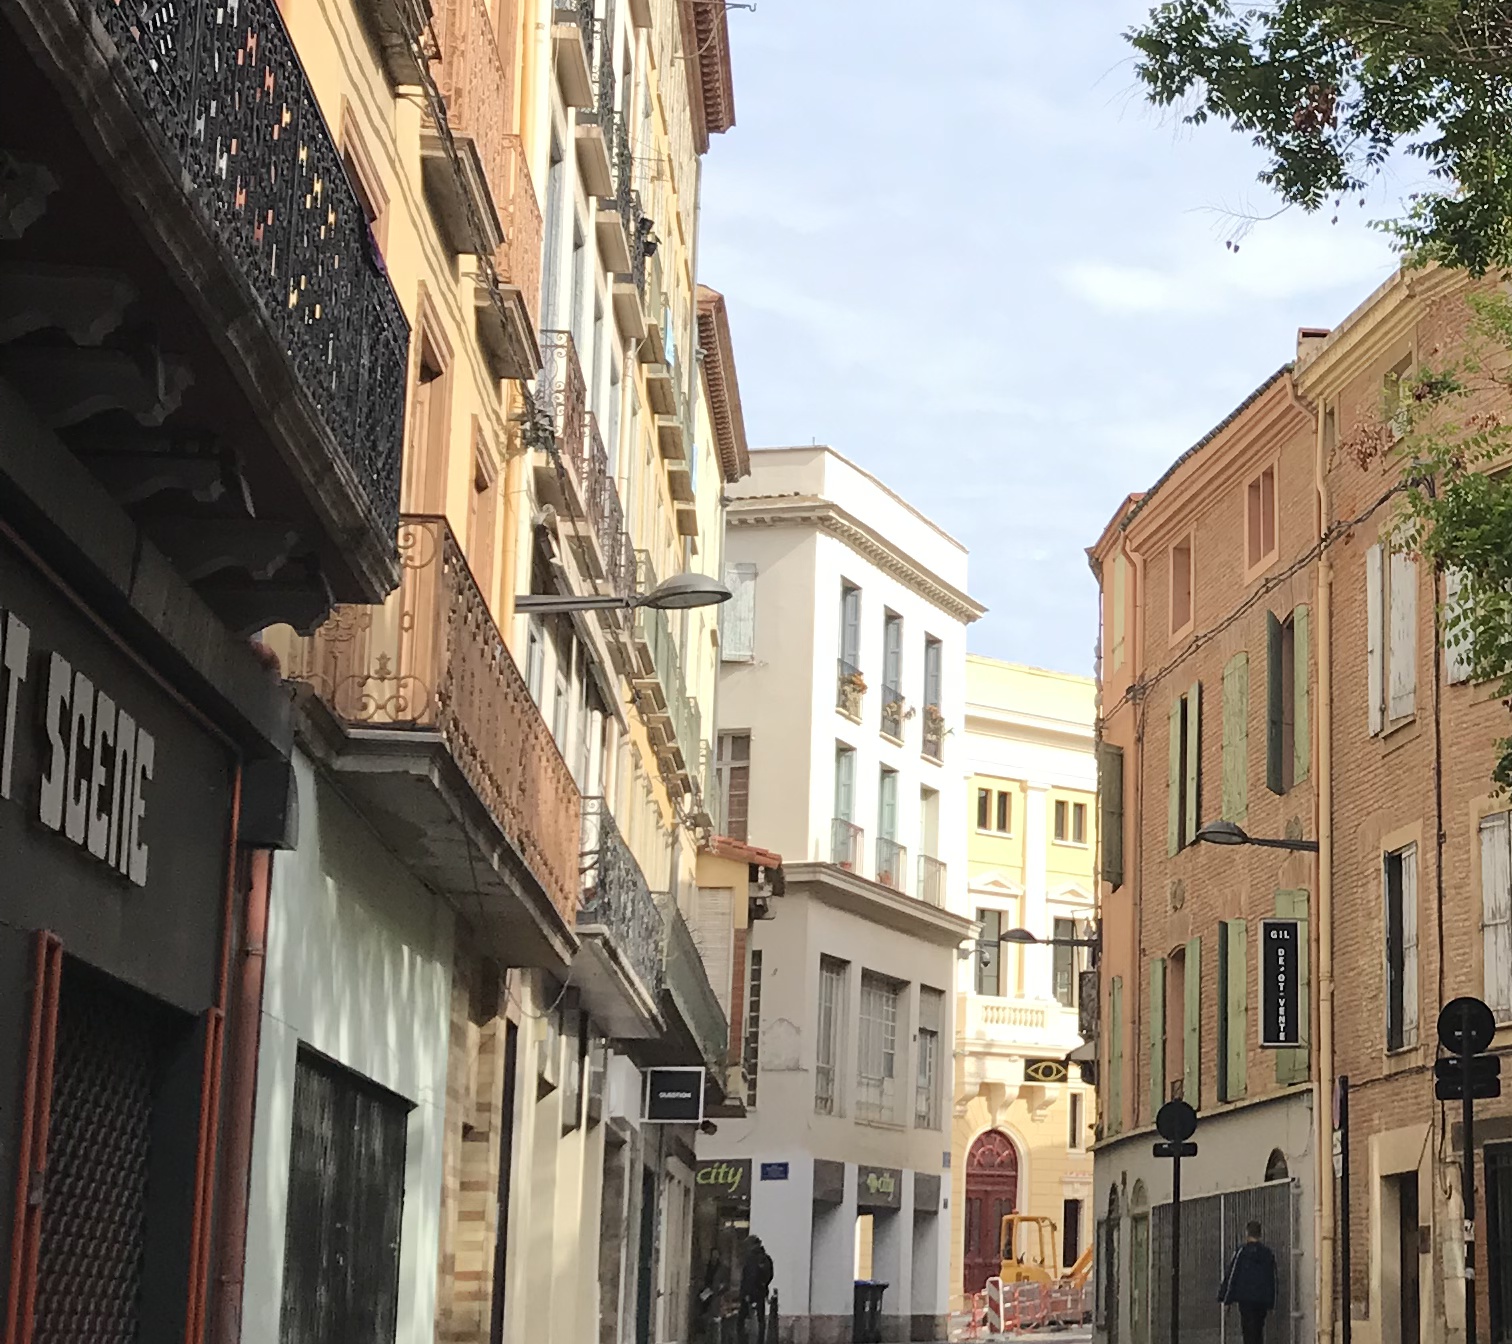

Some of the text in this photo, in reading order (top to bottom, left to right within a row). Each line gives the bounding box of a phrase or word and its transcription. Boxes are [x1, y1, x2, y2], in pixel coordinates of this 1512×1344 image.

[0, 612, 30, 800] T
[1270, 930, 1290, 939] GIL
[696, 1162, 743, 1193] city
